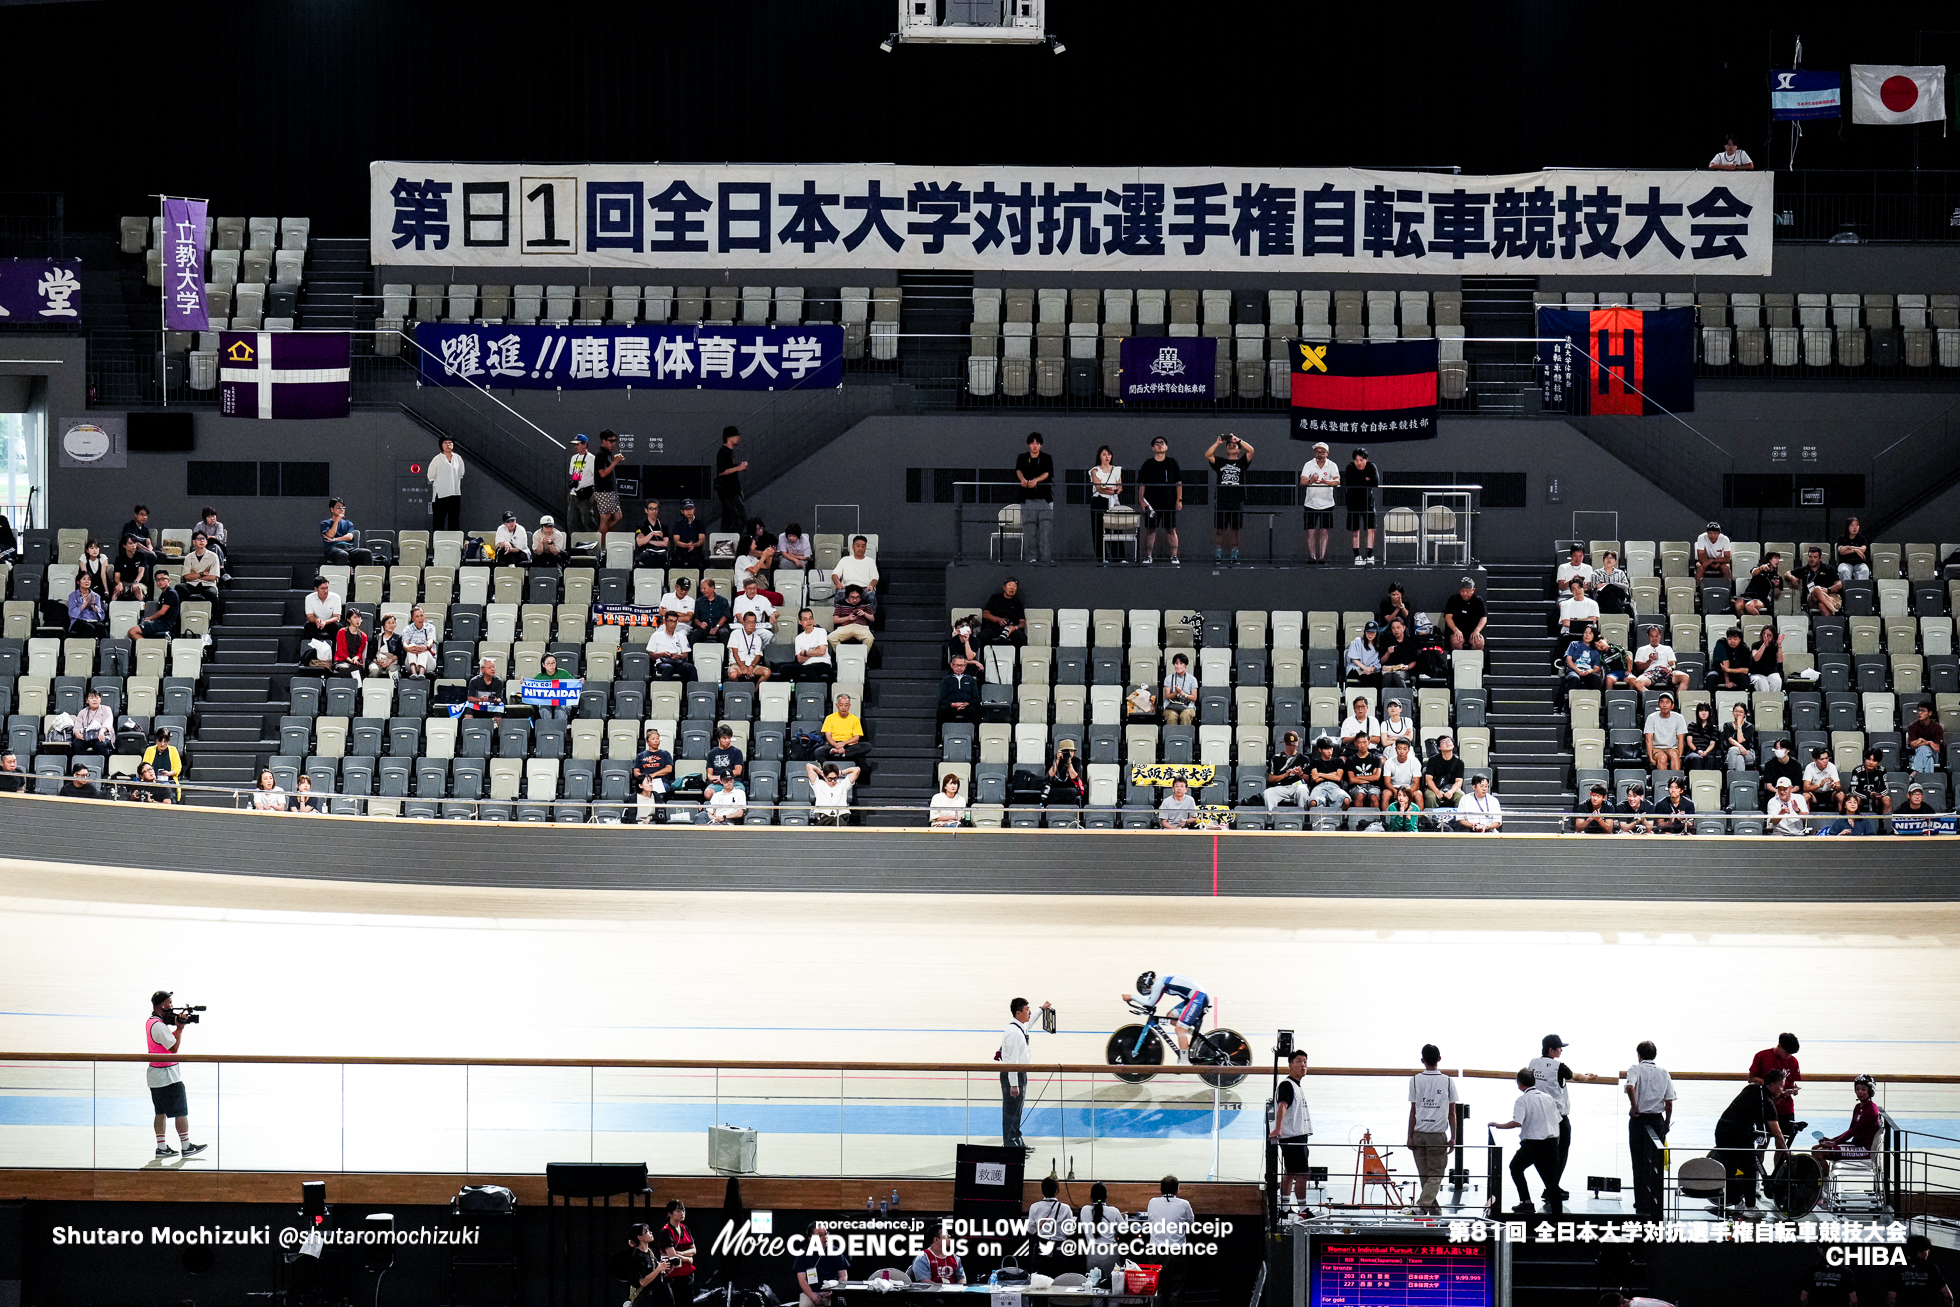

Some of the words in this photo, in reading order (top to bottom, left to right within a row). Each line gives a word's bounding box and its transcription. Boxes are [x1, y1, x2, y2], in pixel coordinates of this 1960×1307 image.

[175, 220, 200, 315] 立教大学
[1129, 383, 1206, 394] 関西大学体育会自転車部
[603, 613, 632, 621] KANSAI
[524, 688, 580, 698] NITTAIDAI
[979, 1169, 1003, 1181] 救護
[1389, 1246, 1413, 1254] Pursuit
[1332, 1296, 1346, 1304] gold
